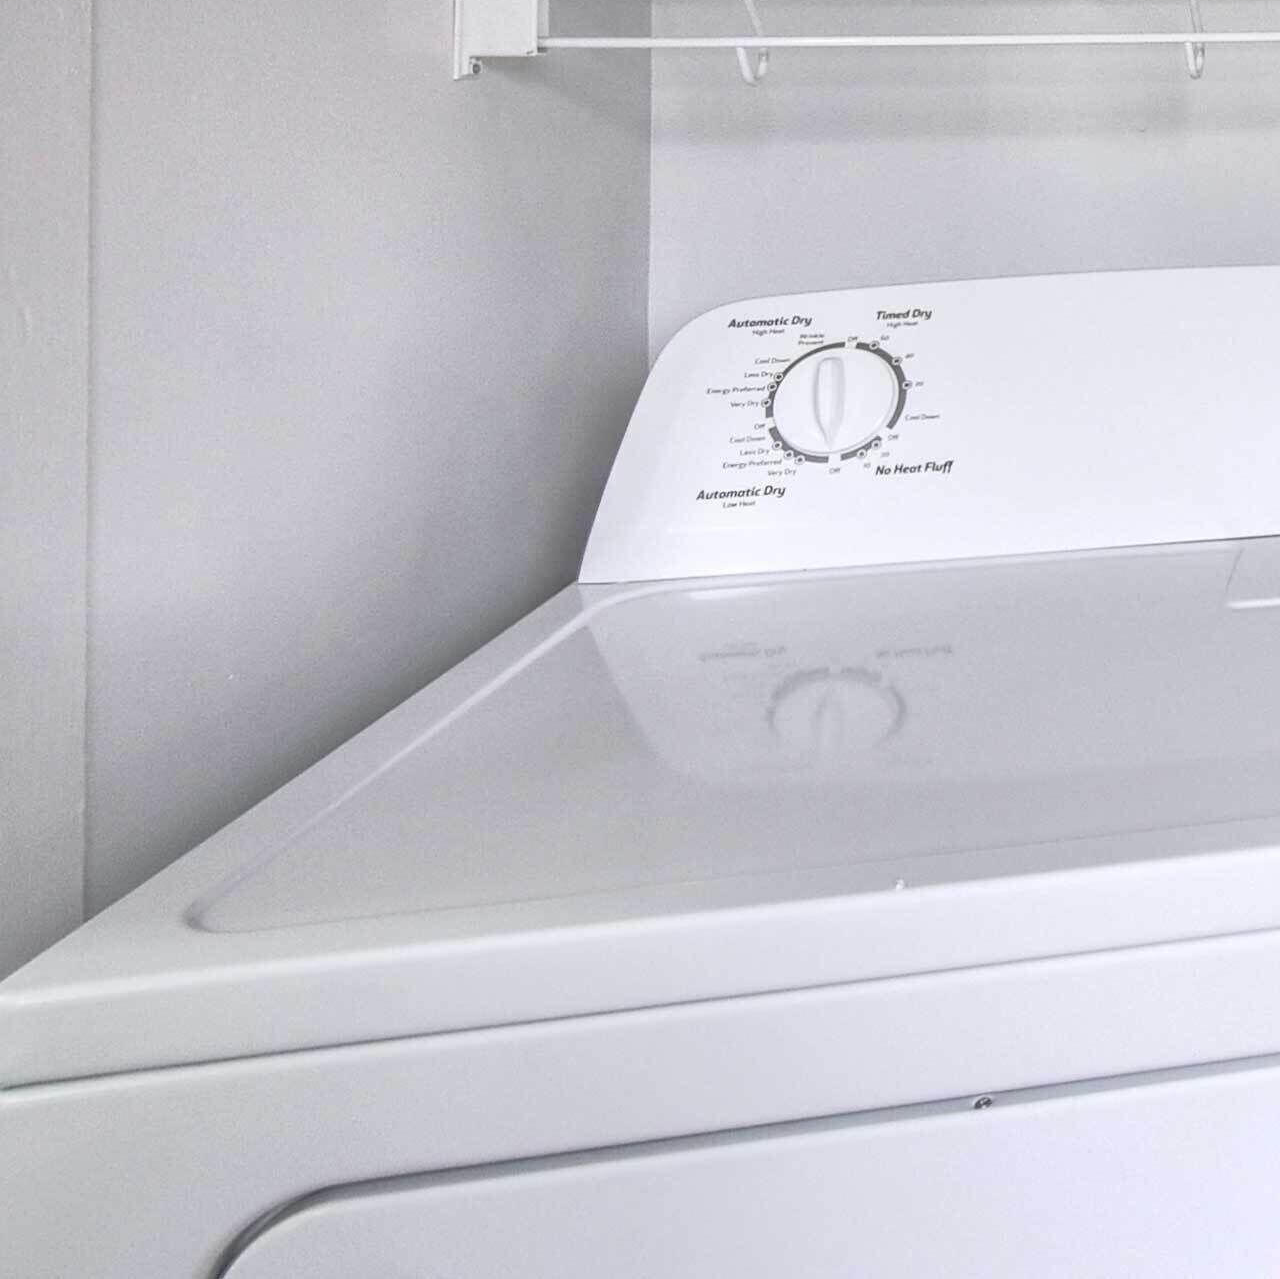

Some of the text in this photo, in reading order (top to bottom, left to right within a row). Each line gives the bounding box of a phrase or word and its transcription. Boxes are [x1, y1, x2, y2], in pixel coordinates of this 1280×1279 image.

[727, 315, 813, 328] Automatic Dry
[876, 308, 933, 321] Timed Dry
[875, 460, 954, 476] No Heat Fluff
[695, 485, 786, 501] Automatic Dry
